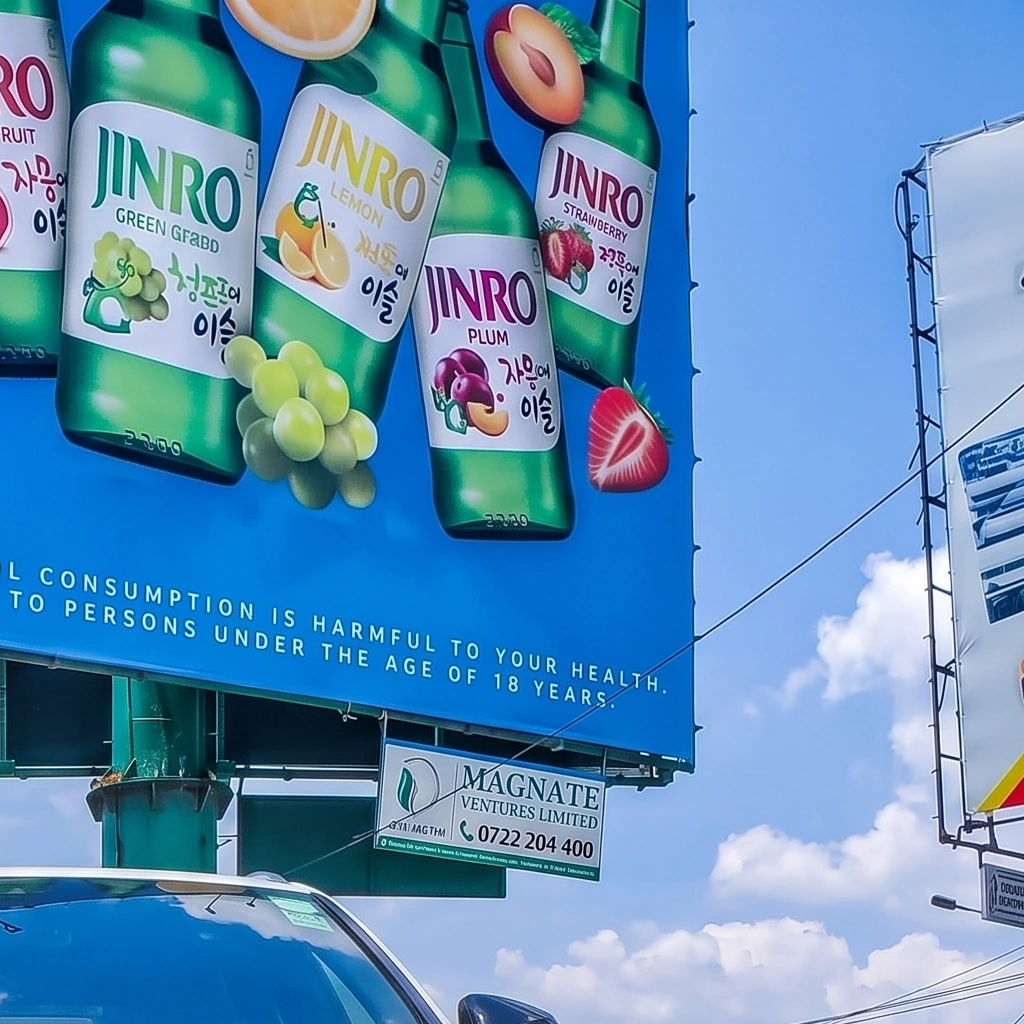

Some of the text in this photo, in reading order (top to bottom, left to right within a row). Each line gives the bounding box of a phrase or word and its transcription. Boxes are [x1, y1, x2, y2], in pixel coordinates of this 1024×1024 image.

[91, 125, 241, 233] JINRO
[296, 102, 426, 223] JINRO
[330, 181, 384, 229] LEMON
[548, 146, 644, 230] JINRO
[116, 207, 166, 237] GREEN
[563, 201, 628, 244] STRAWBERRY
[361, 276, 399, 325] 이슬
[424, 264, 538, 335] JINRO
[607, 277, 635, 314] 이슬
[468, 327, 509, 346] PLUM
[521, 387, 556, 435] 이슬
[9, 589, 45, 614] TO
[64, 599, 197, 639] PERSONS
[214, 624, 305, 657] UNDER
[321, 642, 369, 668] THE
[385, 654, 433, 679] AGE
[448, 665, 477, 686] OF
[493, 673, 519, 693] 18
[534, 680, 616, 709] YEARS.
[39, 566, 254, 621] CONSUMPTION
[272, 607, 296, 628] IS
[313, 615, 436, 653] HARMFUL
[451, 639, 479, 660] TO
[495, 647, 558, 675] YOUR
[571, 661, 668, 695] HEALTH.
[462, 764, 600, 811] MAGNATE
[461, 795, 599, 830] VENTURES LIMITED
[478, 824, 521, 848] 0722
[524, 831, 557, 854] 204
[561, 838, 594, 860] 400
